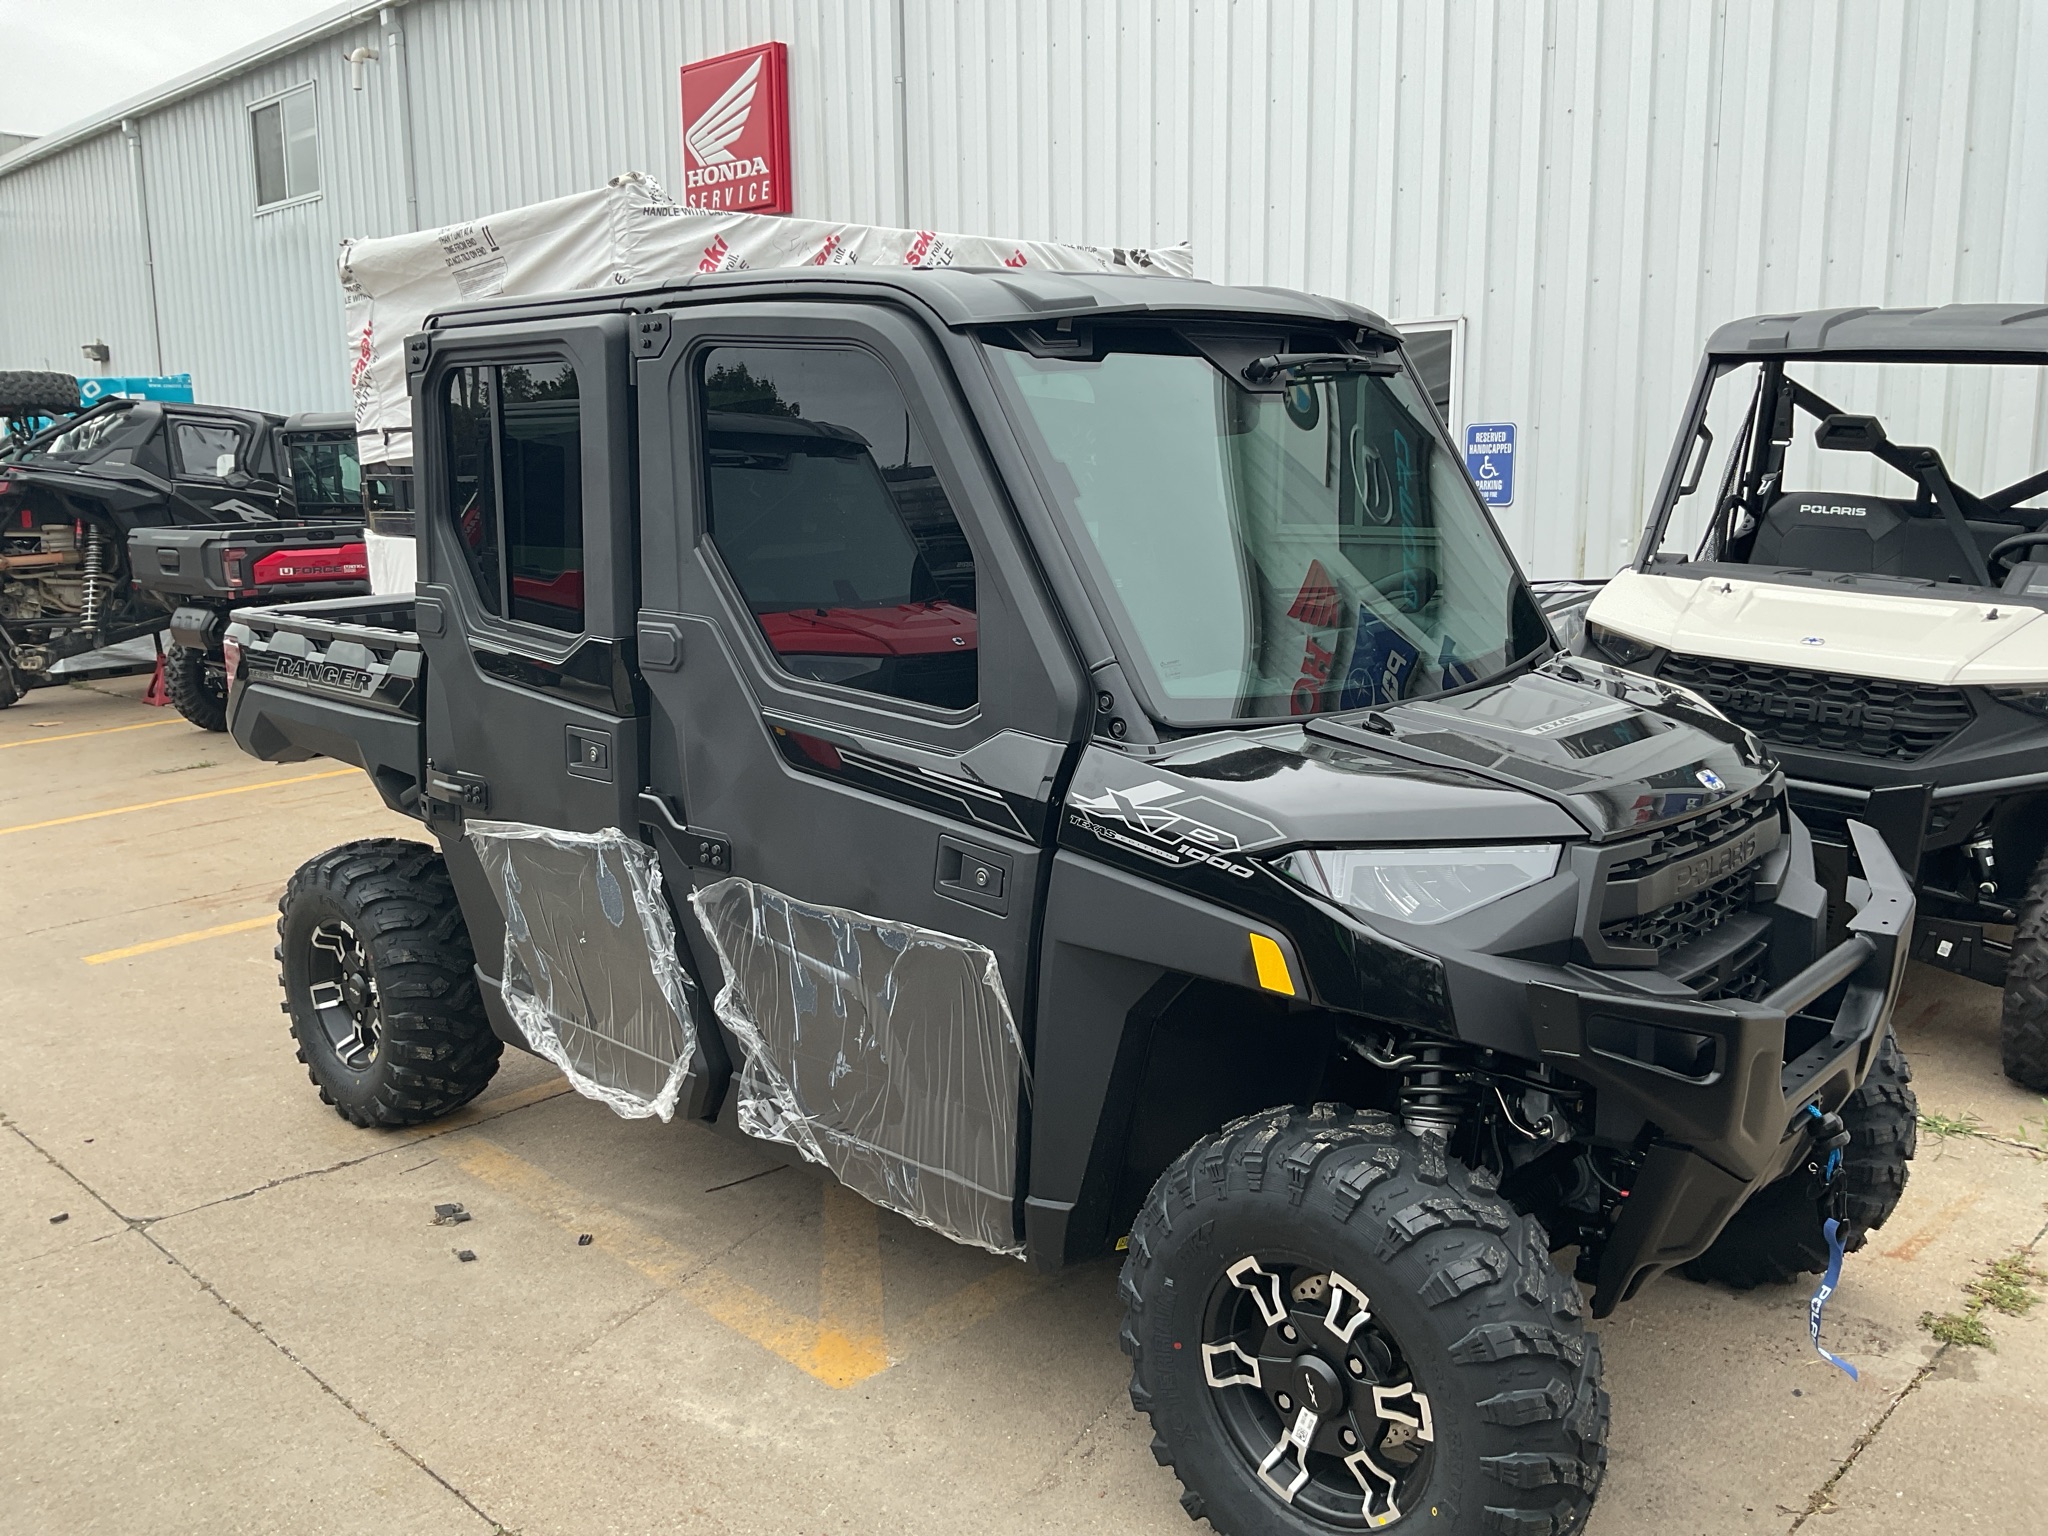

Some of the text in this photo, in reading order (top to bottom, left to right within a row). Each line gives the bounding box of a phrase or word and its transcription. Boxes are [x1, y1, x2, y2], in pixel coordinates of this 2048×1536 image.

[687, 156, 769, 189] HONDA
[688, 181, 770, 211] SERVICE
[643, 206, 680, 217] HANDLE
[681, 208, 706, 217] WITH
[1468, 443, 1512, 455] HANDICAPPED
[1475, 431, 1506, 443] RESERVED
[1475, 479, 1503, 491] PARKING
[1799, 504, 1867, 517] POLARIS
[274, 656, 373, 692] RANGER
[1702, 683, 1895, 731] POLARIS
[1533, 716, 1580, 733] TEXAS
[1069, 814, 1117, 839] TEXAS
[1177, 843, 1256, 879] 1000
[1675, 832, 1756, 894] POLARIS
